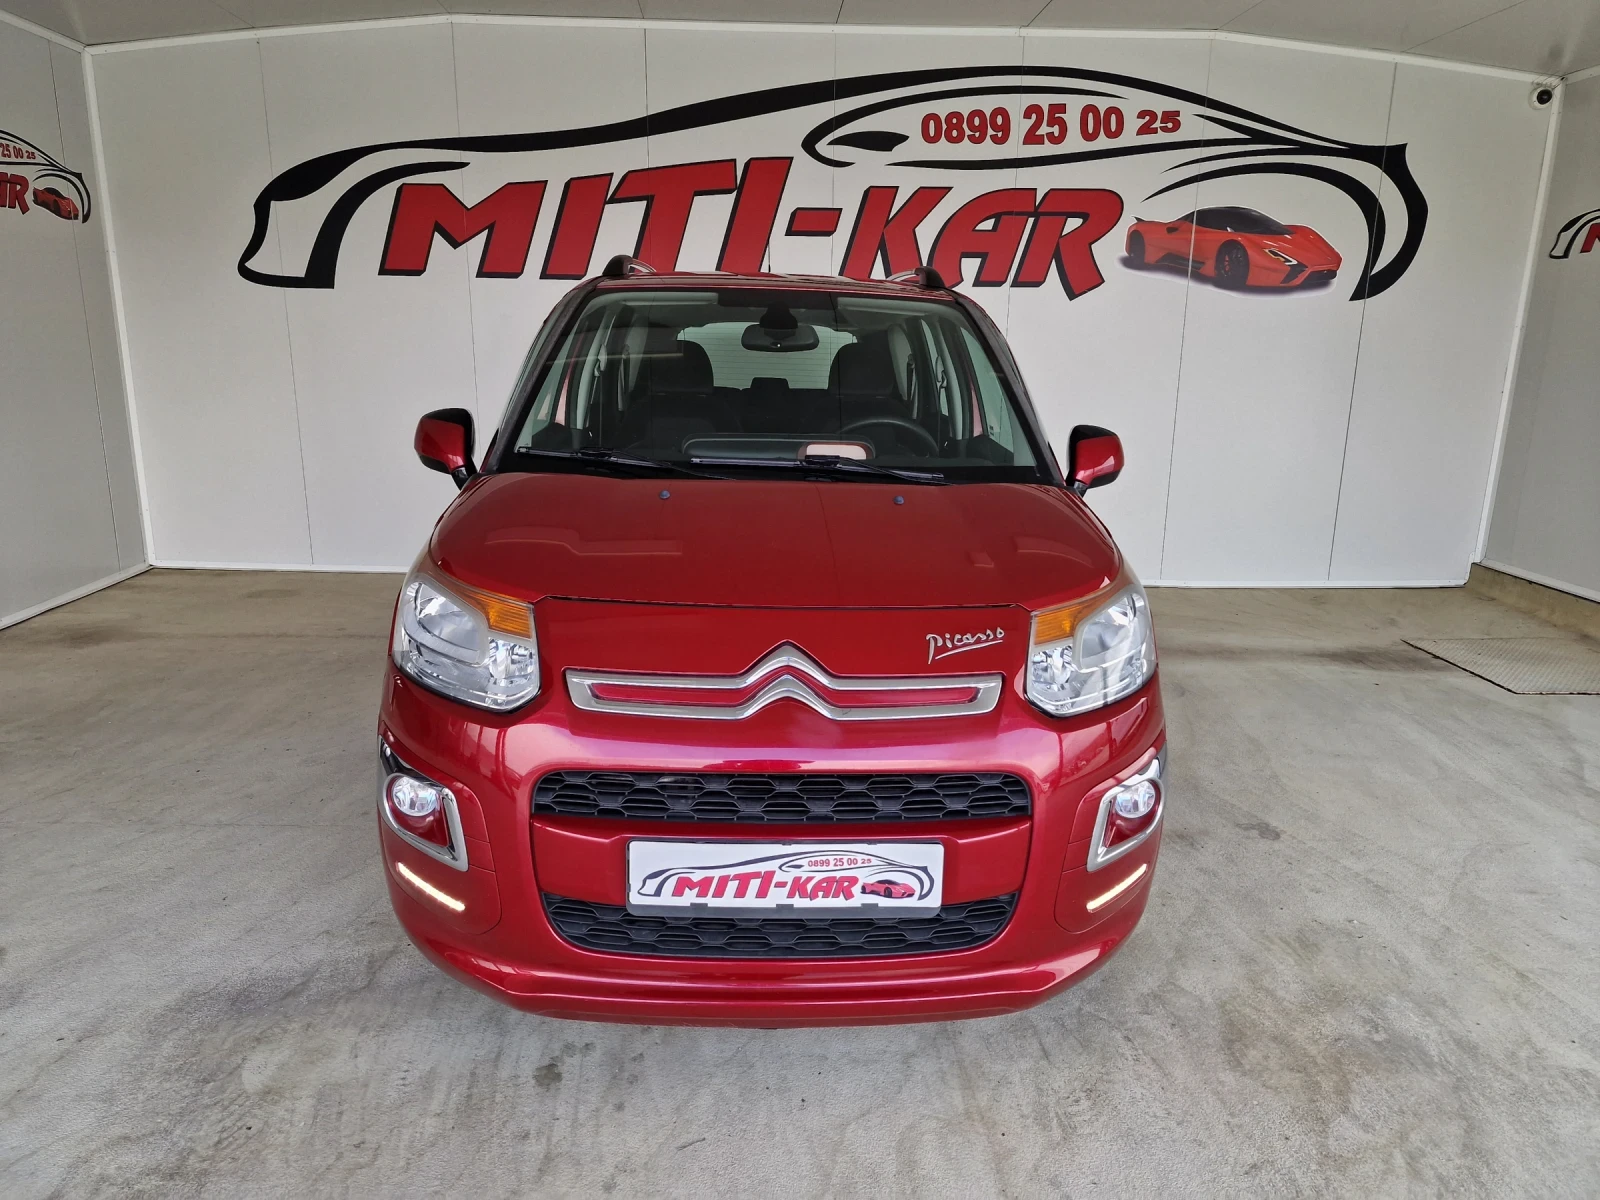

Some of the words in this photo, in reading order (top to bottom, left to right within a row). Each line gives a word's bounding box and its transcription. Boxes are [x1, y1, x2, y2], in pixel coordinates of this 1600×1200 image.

[921, 106, 1011, 145] 0899
[1022, 103, 1068, 146] 25
[1079, 103, 1125, 142] 00
[1136, 109, 1182, 136] 25
[13, 146, 24, 159] 00
[25, 150, 37, 160] 25
[377, 155, 1125, 302] MITI-KAR
[807, 858, 831, 868] 0899
[833, 857, 845, 867] 25
[846, 857, 859, 866] 00
[671, 870, 860, 901] MITI-KAR
